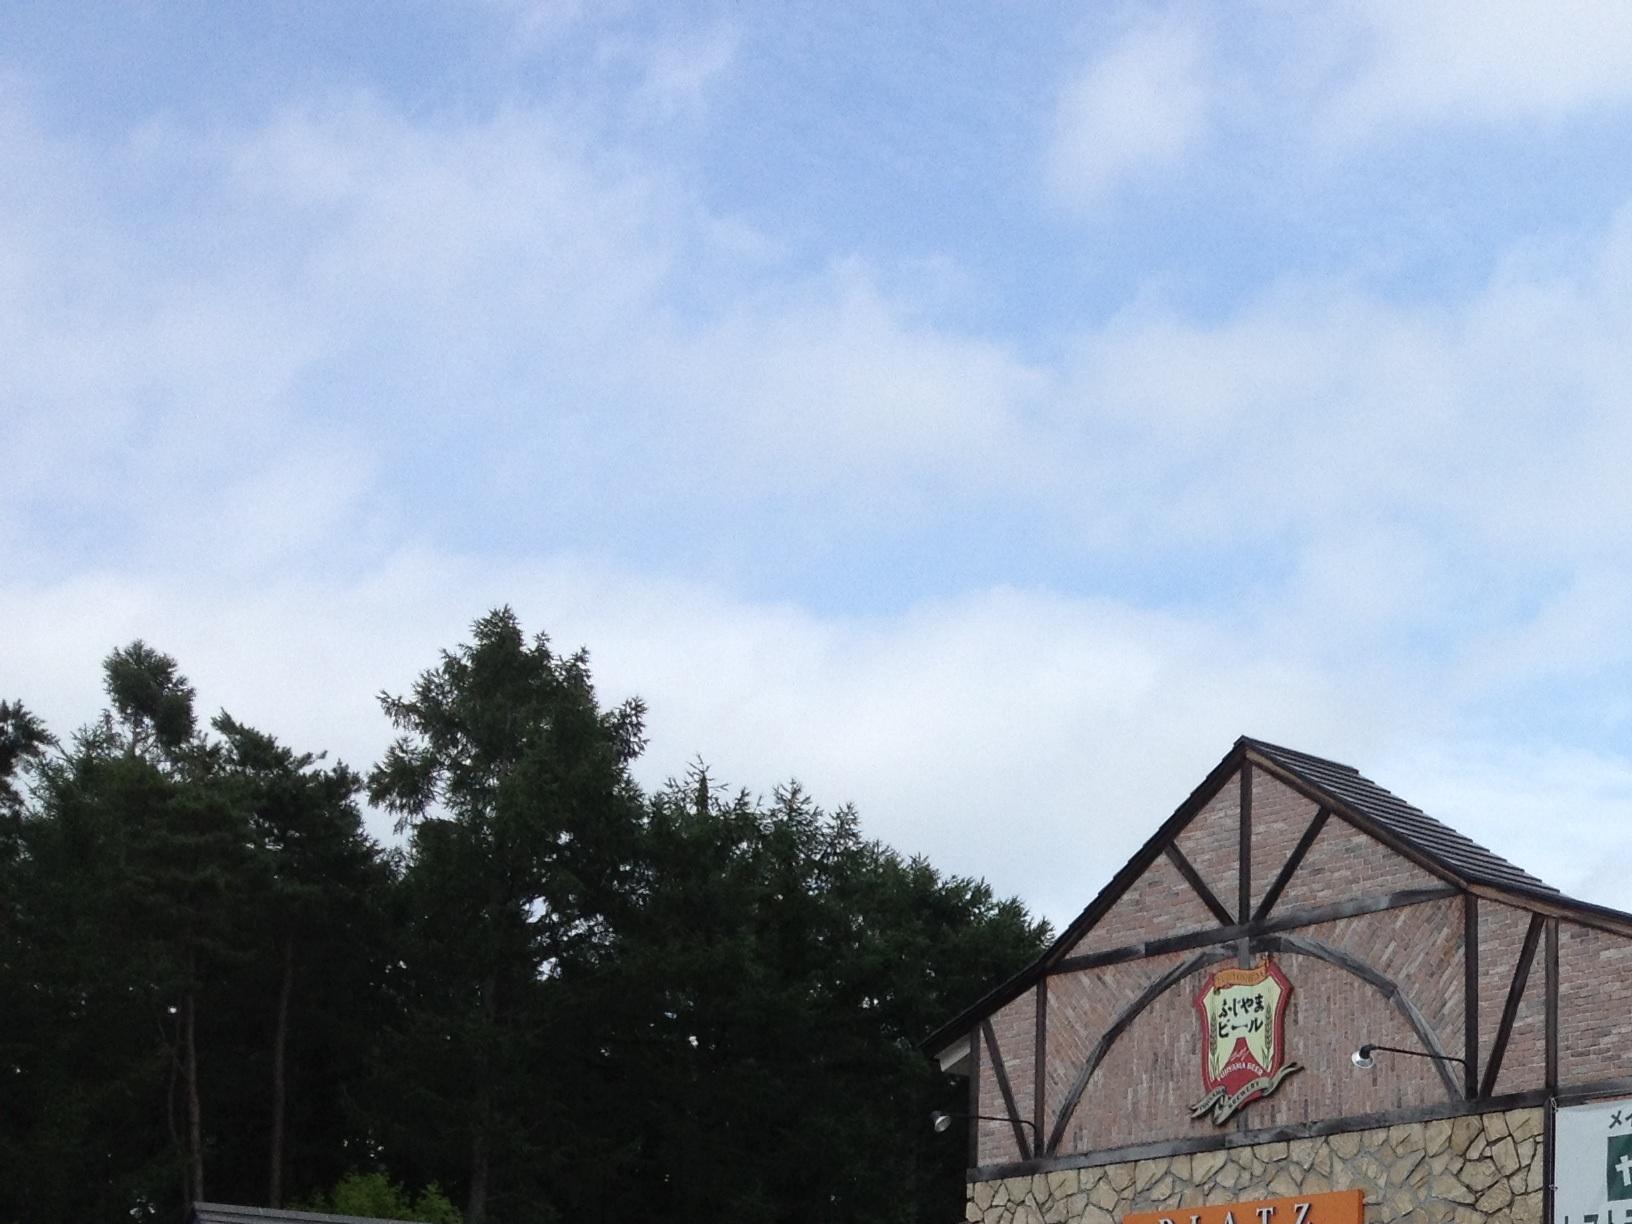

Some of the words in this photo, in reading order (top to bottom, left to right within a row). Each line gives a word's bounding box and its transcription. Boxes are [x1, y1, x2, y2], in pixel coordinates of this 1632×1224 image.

[1218, 993, 1265, 1019] ふじやま
[1217, 1018, 1264, 1039] ビール
